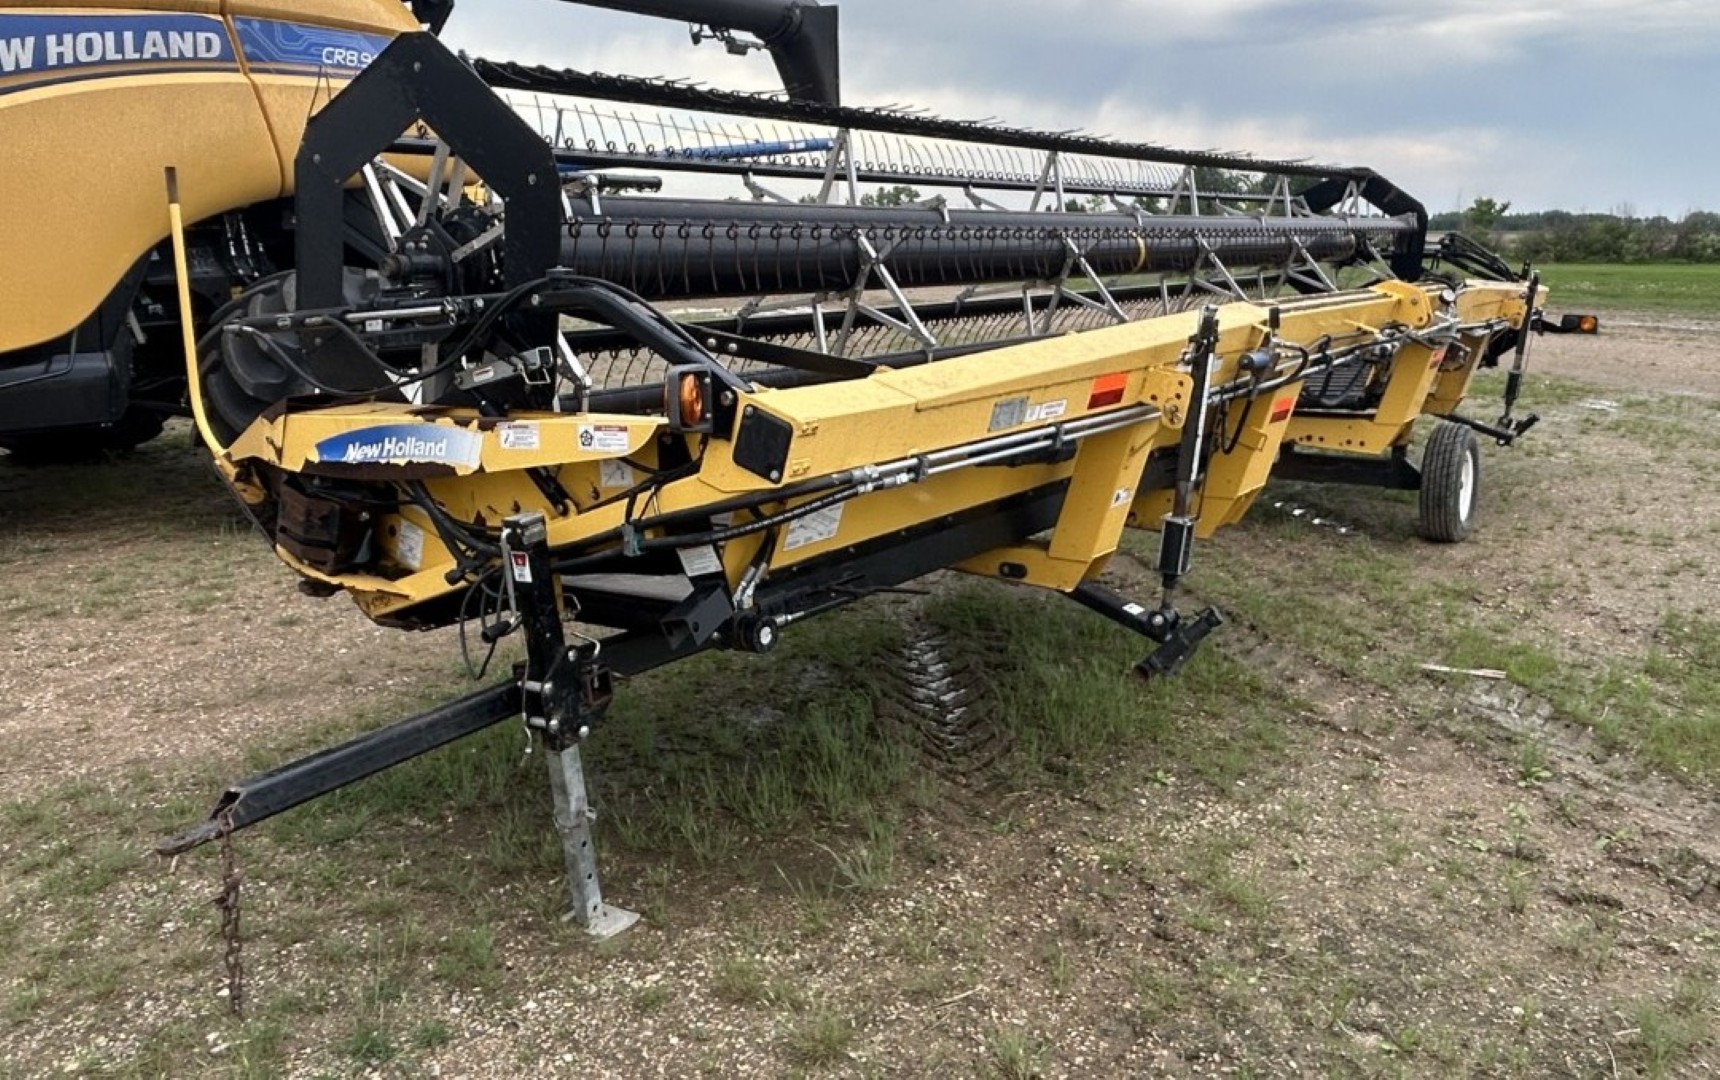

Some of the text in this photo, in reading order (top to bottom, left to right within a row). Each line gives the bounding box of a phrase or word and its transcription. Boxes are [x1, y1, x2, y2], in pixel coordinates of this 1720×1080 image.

[46, 31, 222, 65] HOLLAND
[323, 47, 378, 68] CR8.9
[343, 437, 448, 461] New Holland
